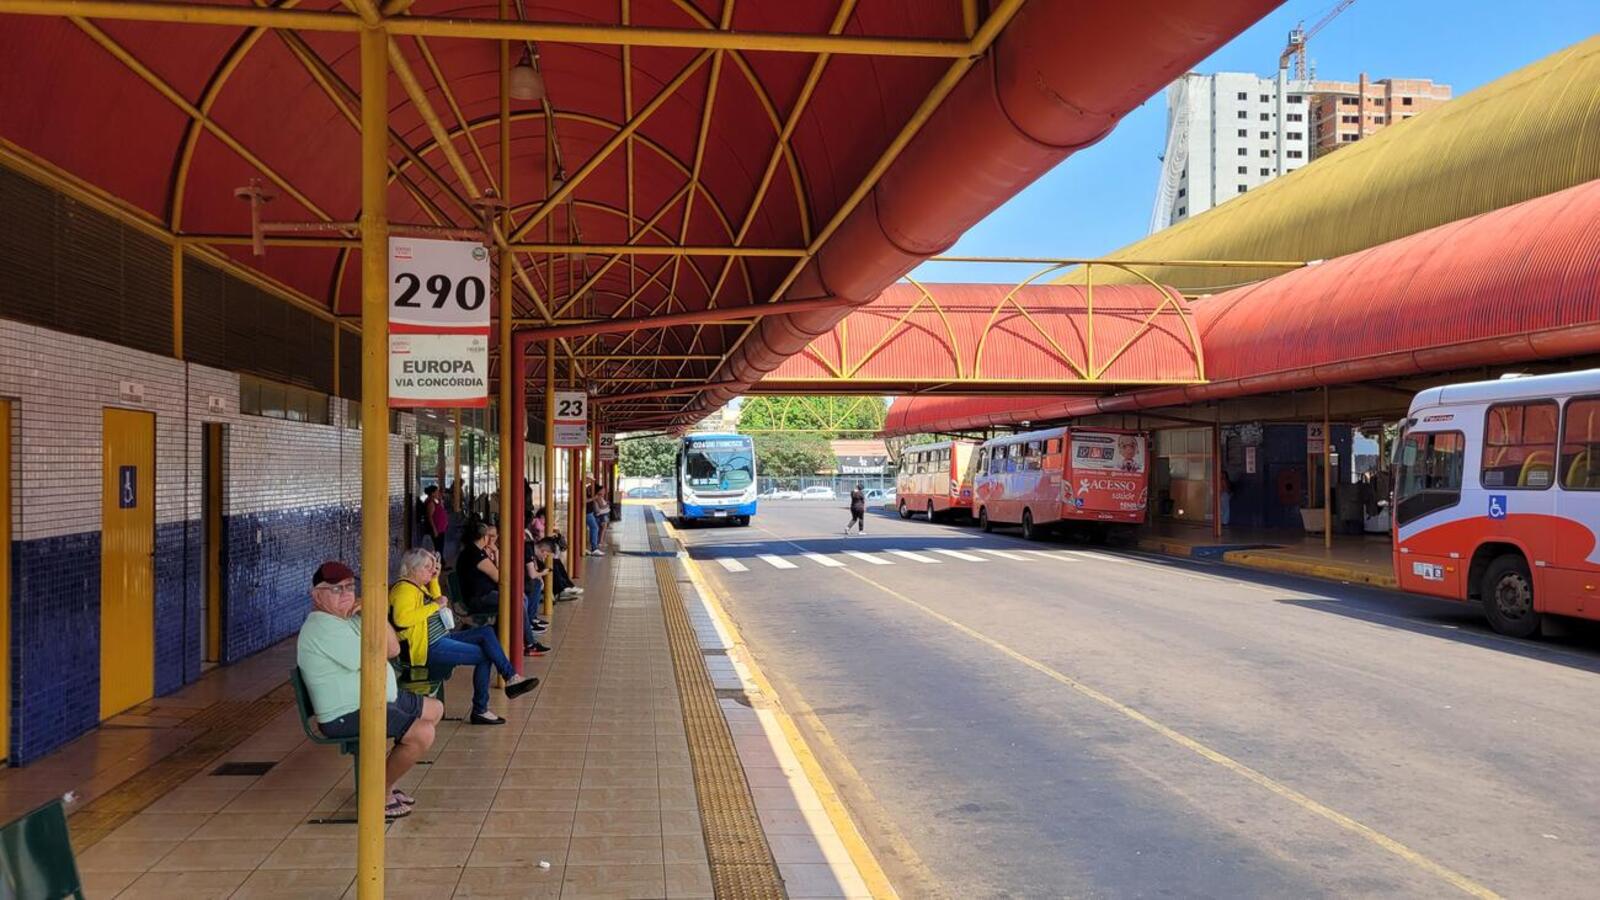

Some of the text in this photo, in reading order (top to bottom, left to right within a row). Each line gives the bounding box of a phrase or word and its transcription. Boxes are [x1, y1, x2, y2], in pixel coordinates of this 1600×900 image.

[394, 272, 486, 311] 290
[403, 360, 475, 374] EUROPA
[395, 376, 484, 387] VIA CONCÓRDIA
[558, 400, 583, 417] 23
[600, 437, 613, 446] 29
[1090, 479, 1136, 491] ACESSO
